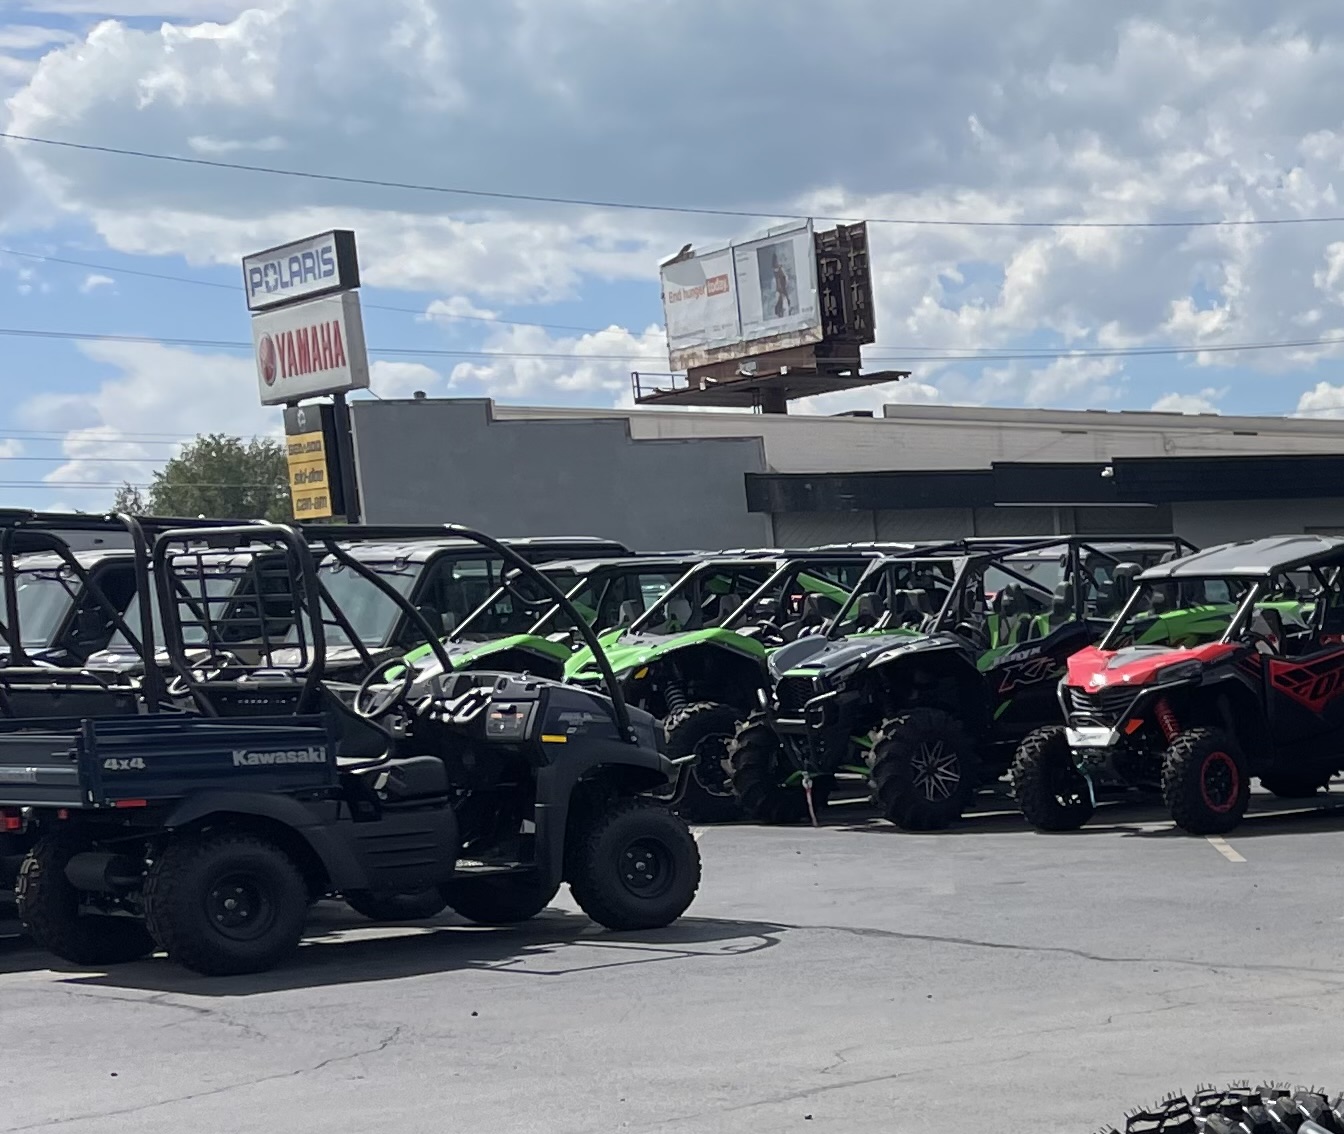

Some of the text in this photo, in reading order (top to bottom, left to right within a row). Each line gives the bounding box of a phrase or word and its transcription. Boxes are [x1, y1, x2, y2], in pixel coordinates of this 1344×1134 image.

[250, 246, 335, 297] POLARIS
[669, 289, 682, 303] End
[683, 284, 705, 301] hunger
[275, 320, 346, 378] YAMAHA
[104, 757, 146, 770] 4x4
[232, 747, 327, 766] Kawasaki
